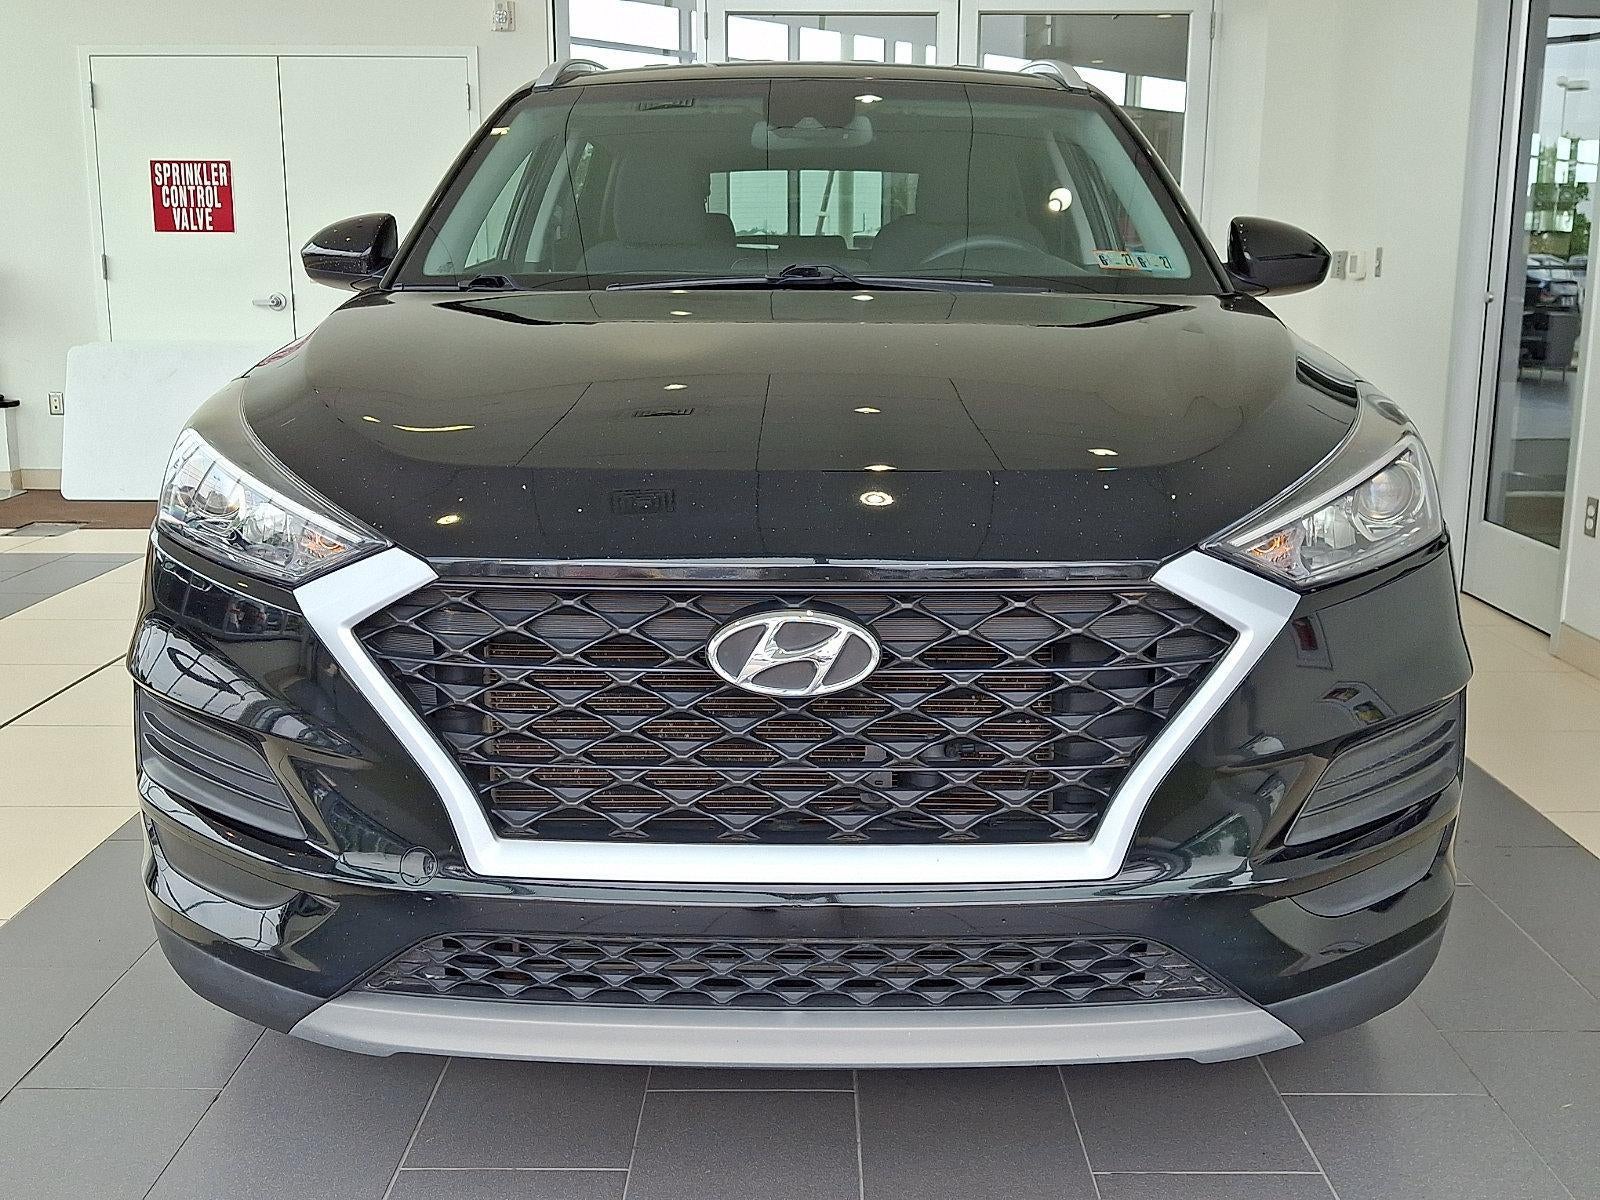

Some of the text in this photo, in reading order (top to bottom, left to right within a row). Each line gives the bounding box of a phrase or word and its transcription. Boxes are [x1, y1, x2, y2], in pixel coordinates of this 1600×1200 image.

[154, 162, 228, 187] SPRINKLER
[161, 185, 222, 208] CONTROL
[172, 207, 214, 231] VALVE
